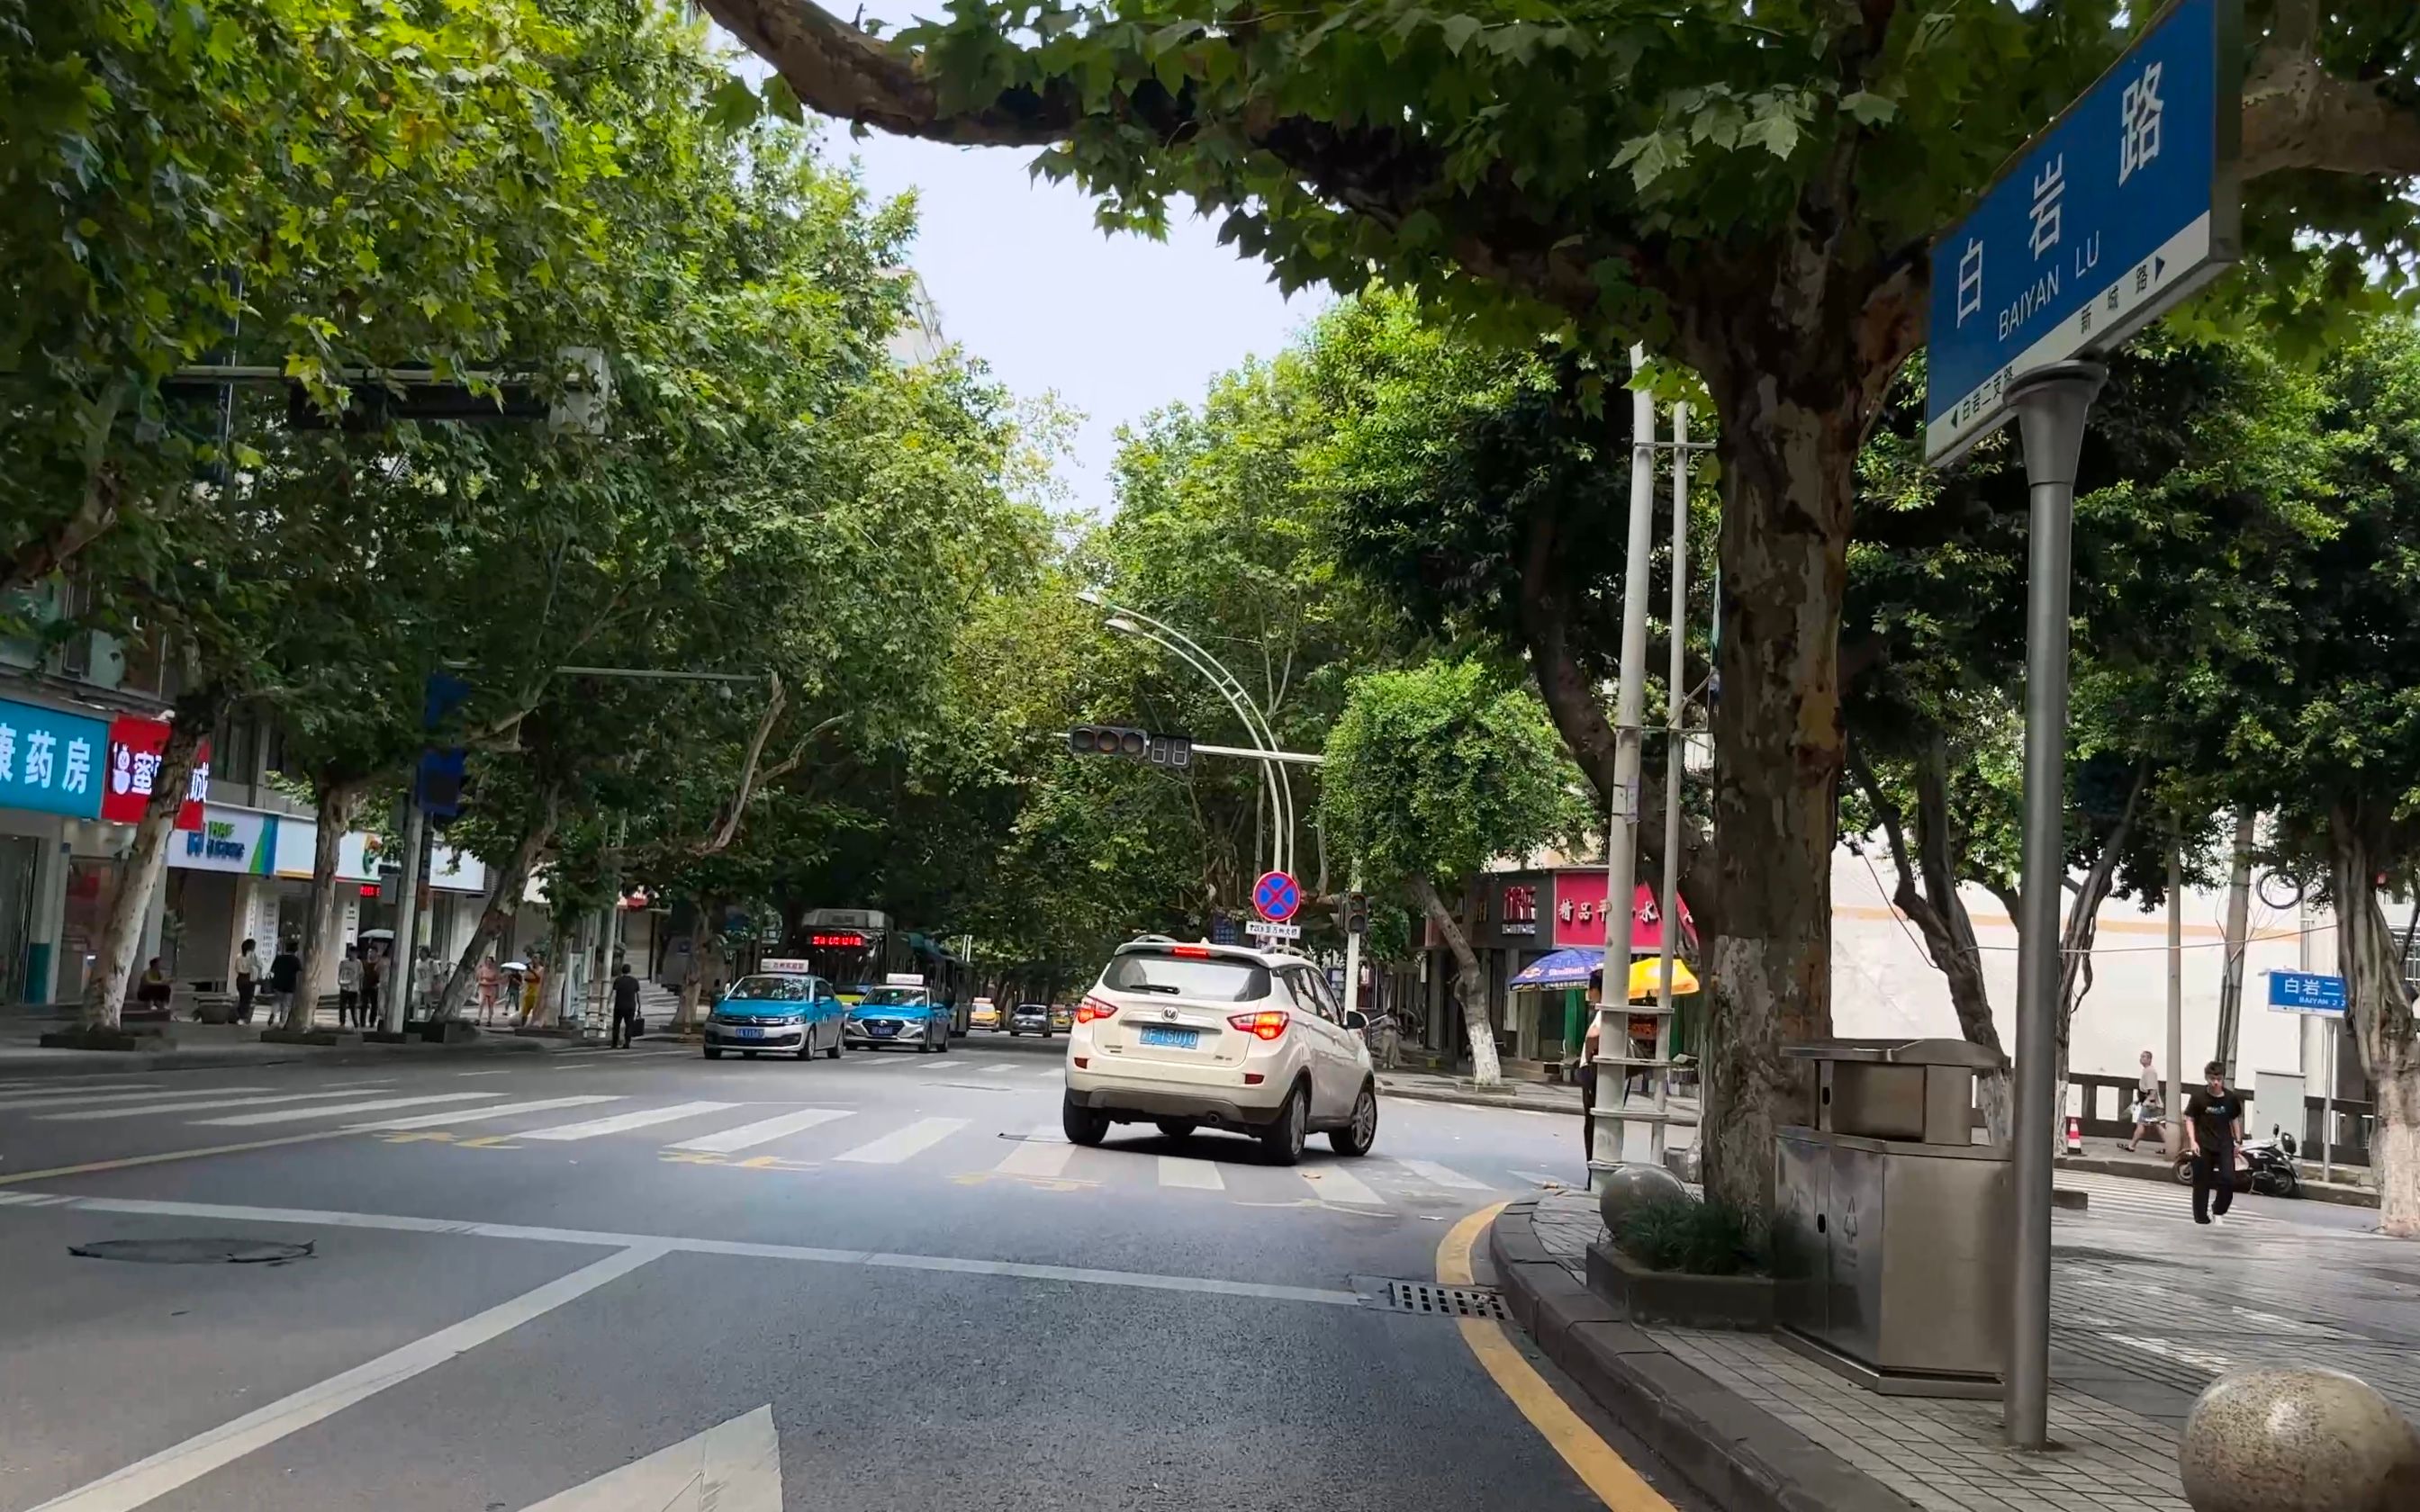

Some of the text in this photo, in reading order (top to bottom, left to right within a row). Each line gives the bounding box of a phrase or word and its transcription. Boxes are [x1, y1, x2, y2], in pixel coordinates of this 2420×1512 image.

[1956, 59, 2164, 329] 白岩路
[1998, 230, 2099, 343] BAIYAN LU
[2284, 977, 2344, 996] 白岩二
